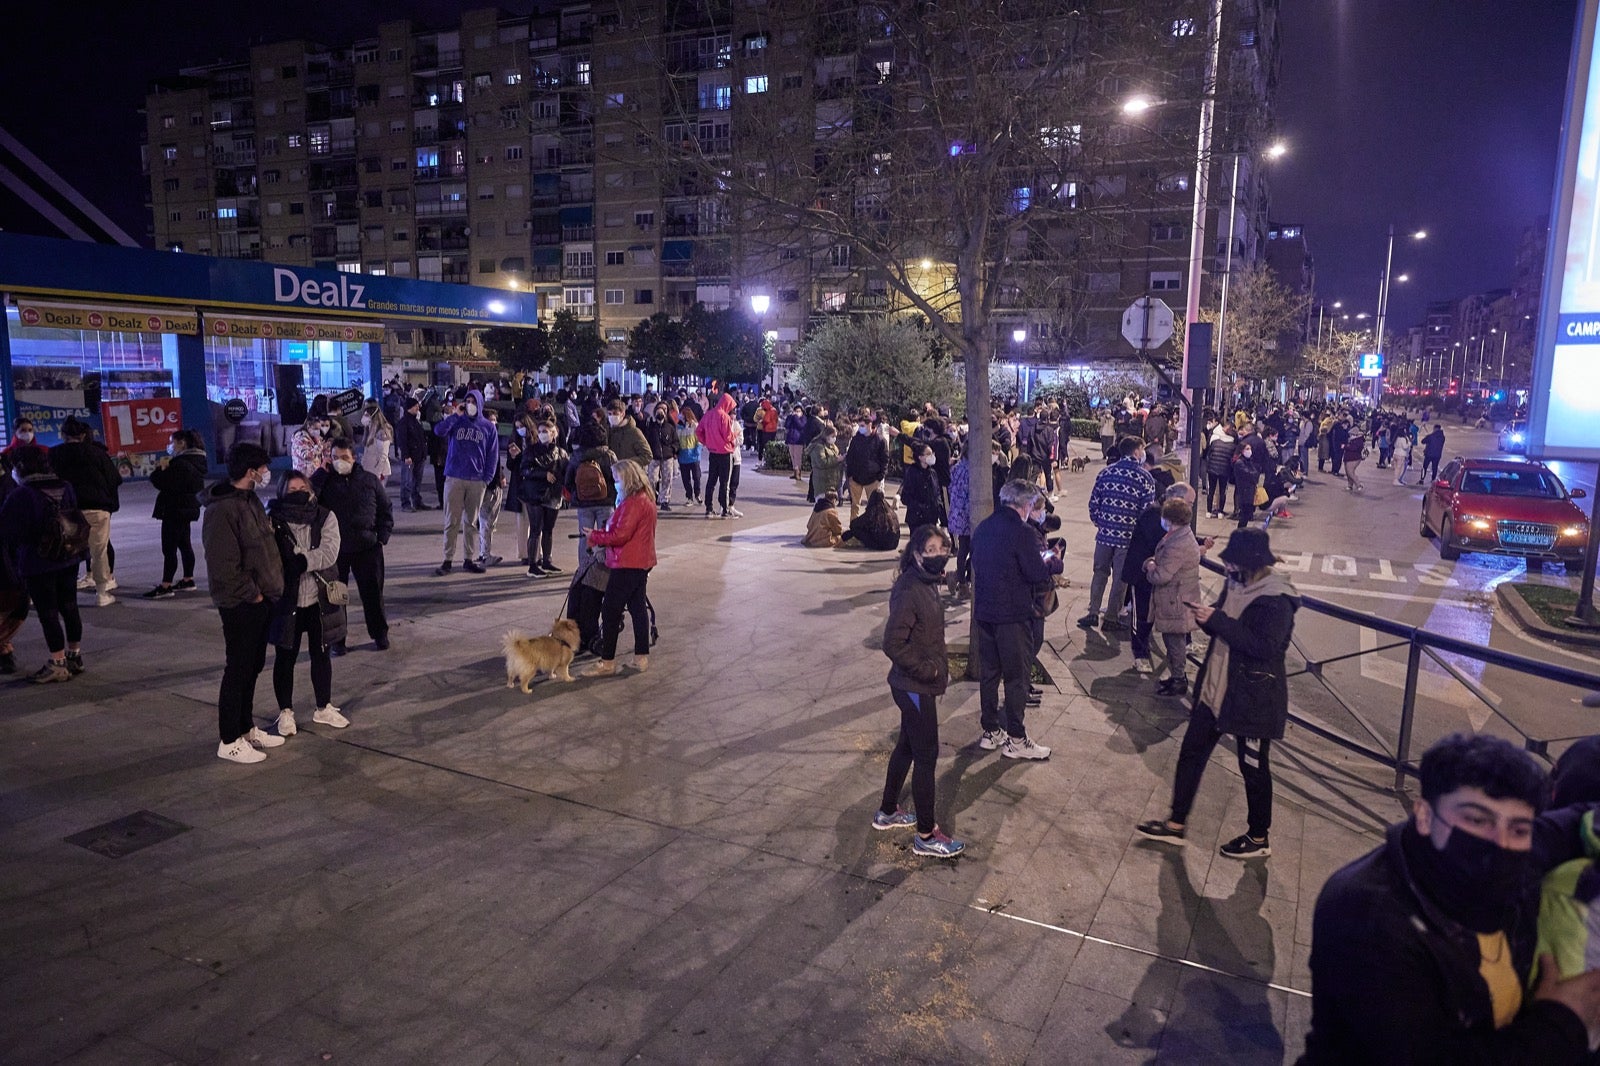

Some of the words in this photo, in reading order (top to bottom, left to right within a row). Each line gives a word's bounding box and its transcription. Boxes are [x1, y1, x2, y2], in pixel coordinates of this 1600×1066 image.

[274, 268, 366, 308] Dealz
[368, 299, 398, 311] Grandes
[399, 303, 425, 313] marcas
[426, 306, 438, 315] por
[438, 306, 460, 316] menos
[460, 307, 478, 318] ¡Cada
[45, 312, 82, 325] Dealz
[108, 316, 143, 329] Dealz
[165, 319, 196, 331] Dealz
[231, 323, 258, 335] Dealz
[276, 326, 301, 337] Dealz
[318, 328, 342, 339] Dealz
[356, 330, 378, 340] Dealz
[1364, 354, 1378, 369] P
[53, 408, 91, 419] IDEAS
[456, 427, 483, 443] GAP
[1273, 551, 1460, 586] STOP
